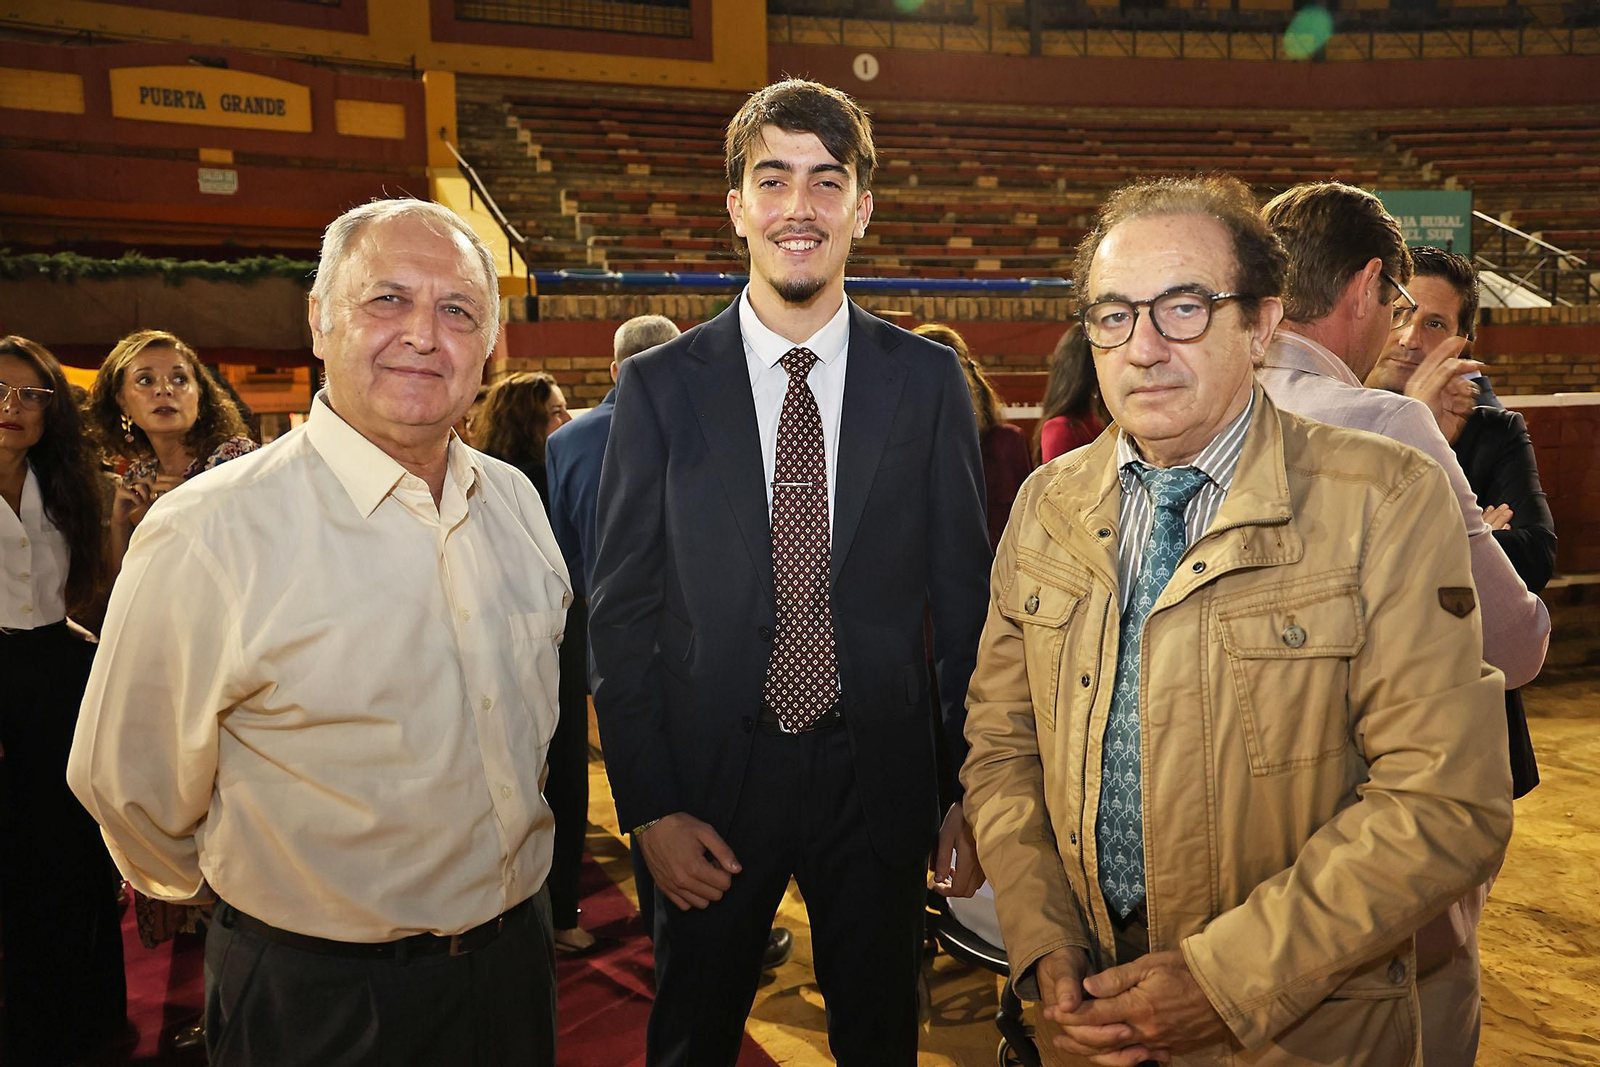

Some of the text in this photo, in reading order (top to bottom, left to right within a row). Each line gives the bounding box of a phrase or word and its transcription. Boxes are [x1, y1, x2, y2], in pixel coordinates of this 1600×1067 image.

[139, 86, 286, 116] PUERTA GRANDE
[1420, 215, 1465, 228] RURAL
[1426, 229, 1455, 240] SUR
